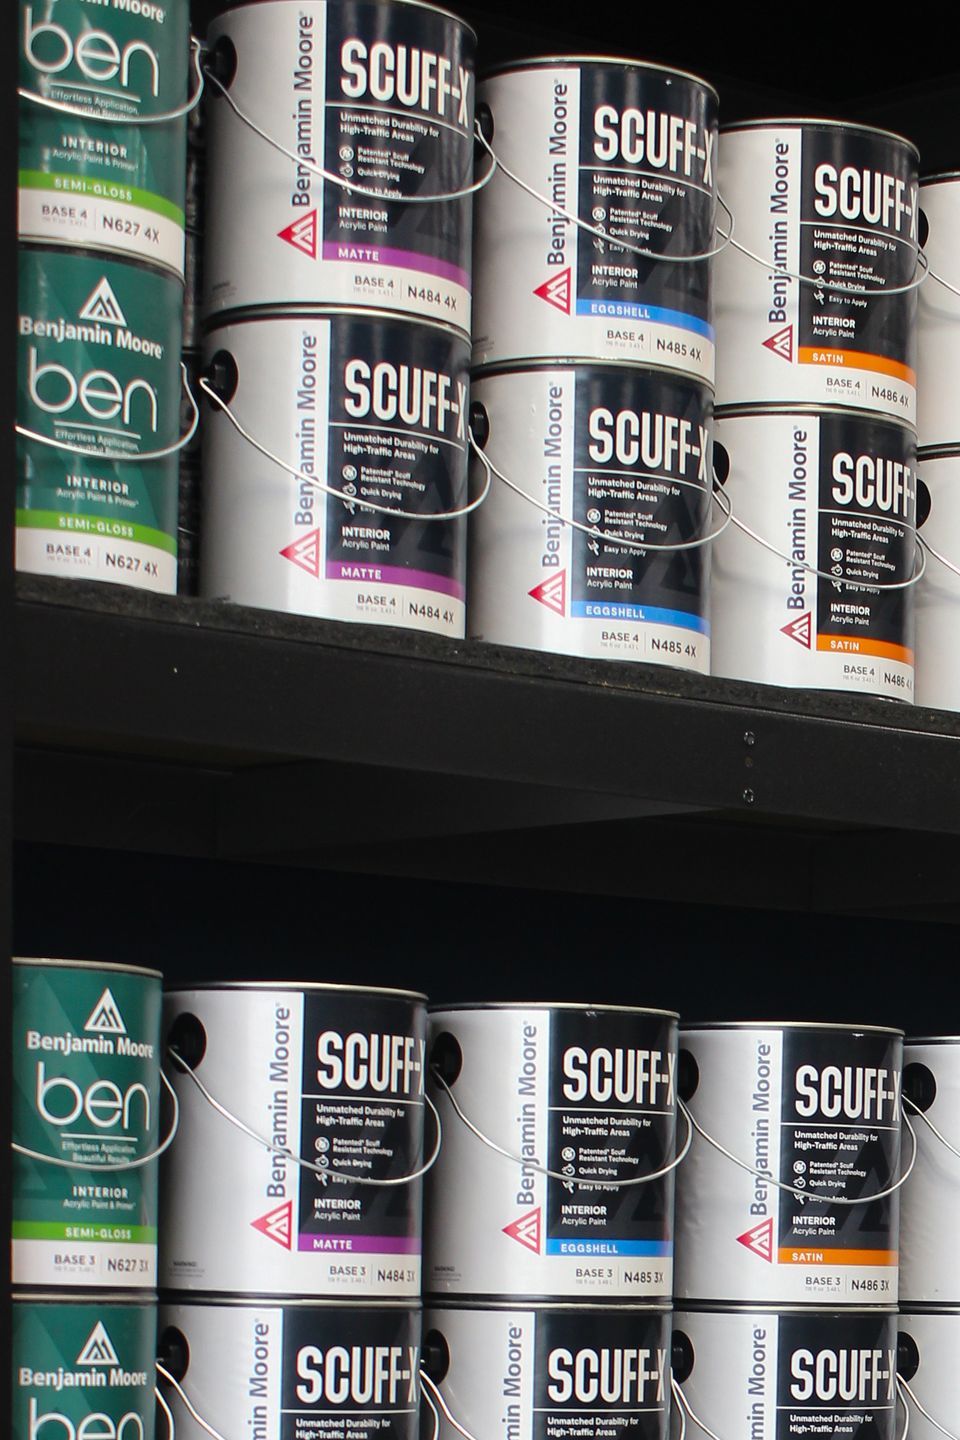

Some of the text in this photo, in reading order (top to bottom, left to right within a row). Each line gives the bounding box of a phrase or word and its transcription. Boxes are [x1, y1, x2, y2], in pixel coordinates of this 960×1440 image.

[23, 6, 159, 97] ben
[339, 37, 468, 129] SCUFF-X
[292, 16, 314, 207] Benjamin Moore
[339, 112, 439, 137] Unmatched Durability for
[339, 124, 414, 143] High-Traffic Areas
[62, 135, 128, 158] INTERIOR
[593, 105, 713, 186] SCUFF-X
[54, 177, 133, 201] SEMI-GLOSS
[102, 215, 140, 238] N627
[144, 227, 161, 244] 4X
[768, 142, 789, 323] Benjamin Moore
[338, 247, 380, 262] MATTE
[592, 264, 638, 278] INTERIOR
[592, 277, 637, 289] Acrylic Paint
[591, 303, 651, 319] EGGSHELL
[19, 316, 162, 359] Benjamin Moore
[607, 328, 644, 342] BASE 4
[812, 352, 844, 363] SATIN
[28, 346, 157, 433] ben
[542, 386, 562, 567] Benjamin Moore
[341, 527, 391, 541] INTERIOR
[586, 605, 645, 619] EGGSHELL
[830, 604, 871, 616] INTERIOR
[651, 638, 683, 653] N485
[684, 646, 696, 658] 4X
[830, 640, 859, 651] SATIN
[27, 1031, 153, 1058] Benjamin Moore
[563, 1046, 675, 1105] SCUFF-X
[37, 1061, 150, 1130] ben
[562, 1115, 651, 1129] Unmatched Durability for
[809, 1179, 846, 1189] Quick Drying
[314, 1199, 361, 1210] INTERIOR
[313, 1239, 352, 1250] MATTE
[561, 1243, 618, 1254] EGGSHELL
[107, 1257, 136, 1272] N627
[139, 1259, 149, 1273] 3X
[791, 1252, 823, 1262] SATIN
[329, 1265, 366, 1276] BASE 3
[851, 1279, 890, 1291] N486 3X
[790, 1424, 853, 1435] High-Traffic Areas
